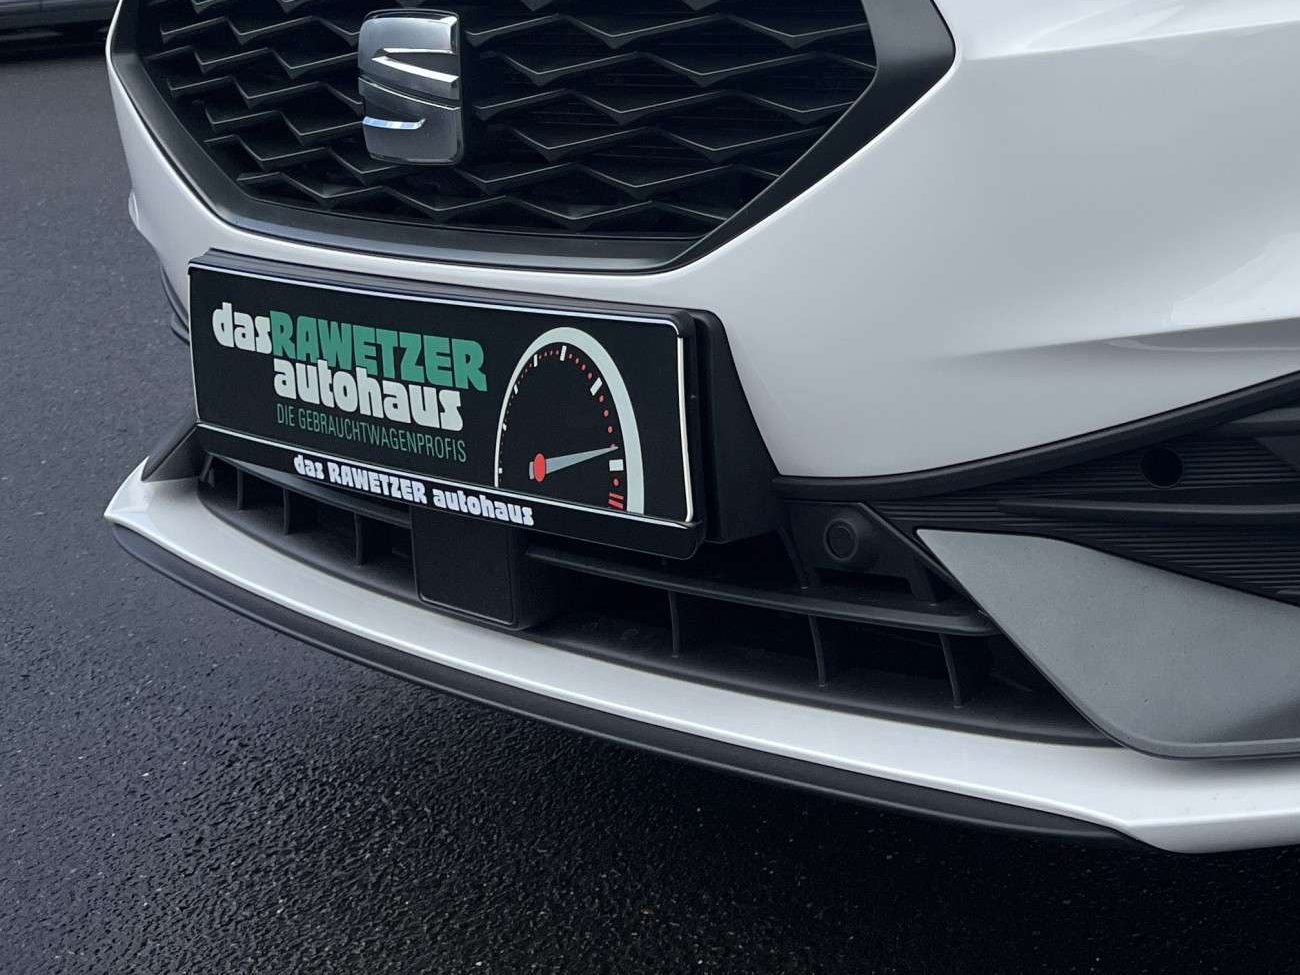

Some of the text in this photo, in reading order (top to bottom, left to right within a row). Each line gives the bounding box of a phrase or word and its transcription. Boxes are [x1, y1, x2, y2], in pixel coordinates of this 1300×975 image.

[273, 358, 463, 432] autohaus
[276, 403, 468, 463] DIE GEBRAUCHTWAGENPROFIS
[293, 454, 535, 526] das RAWETZER autohaus
